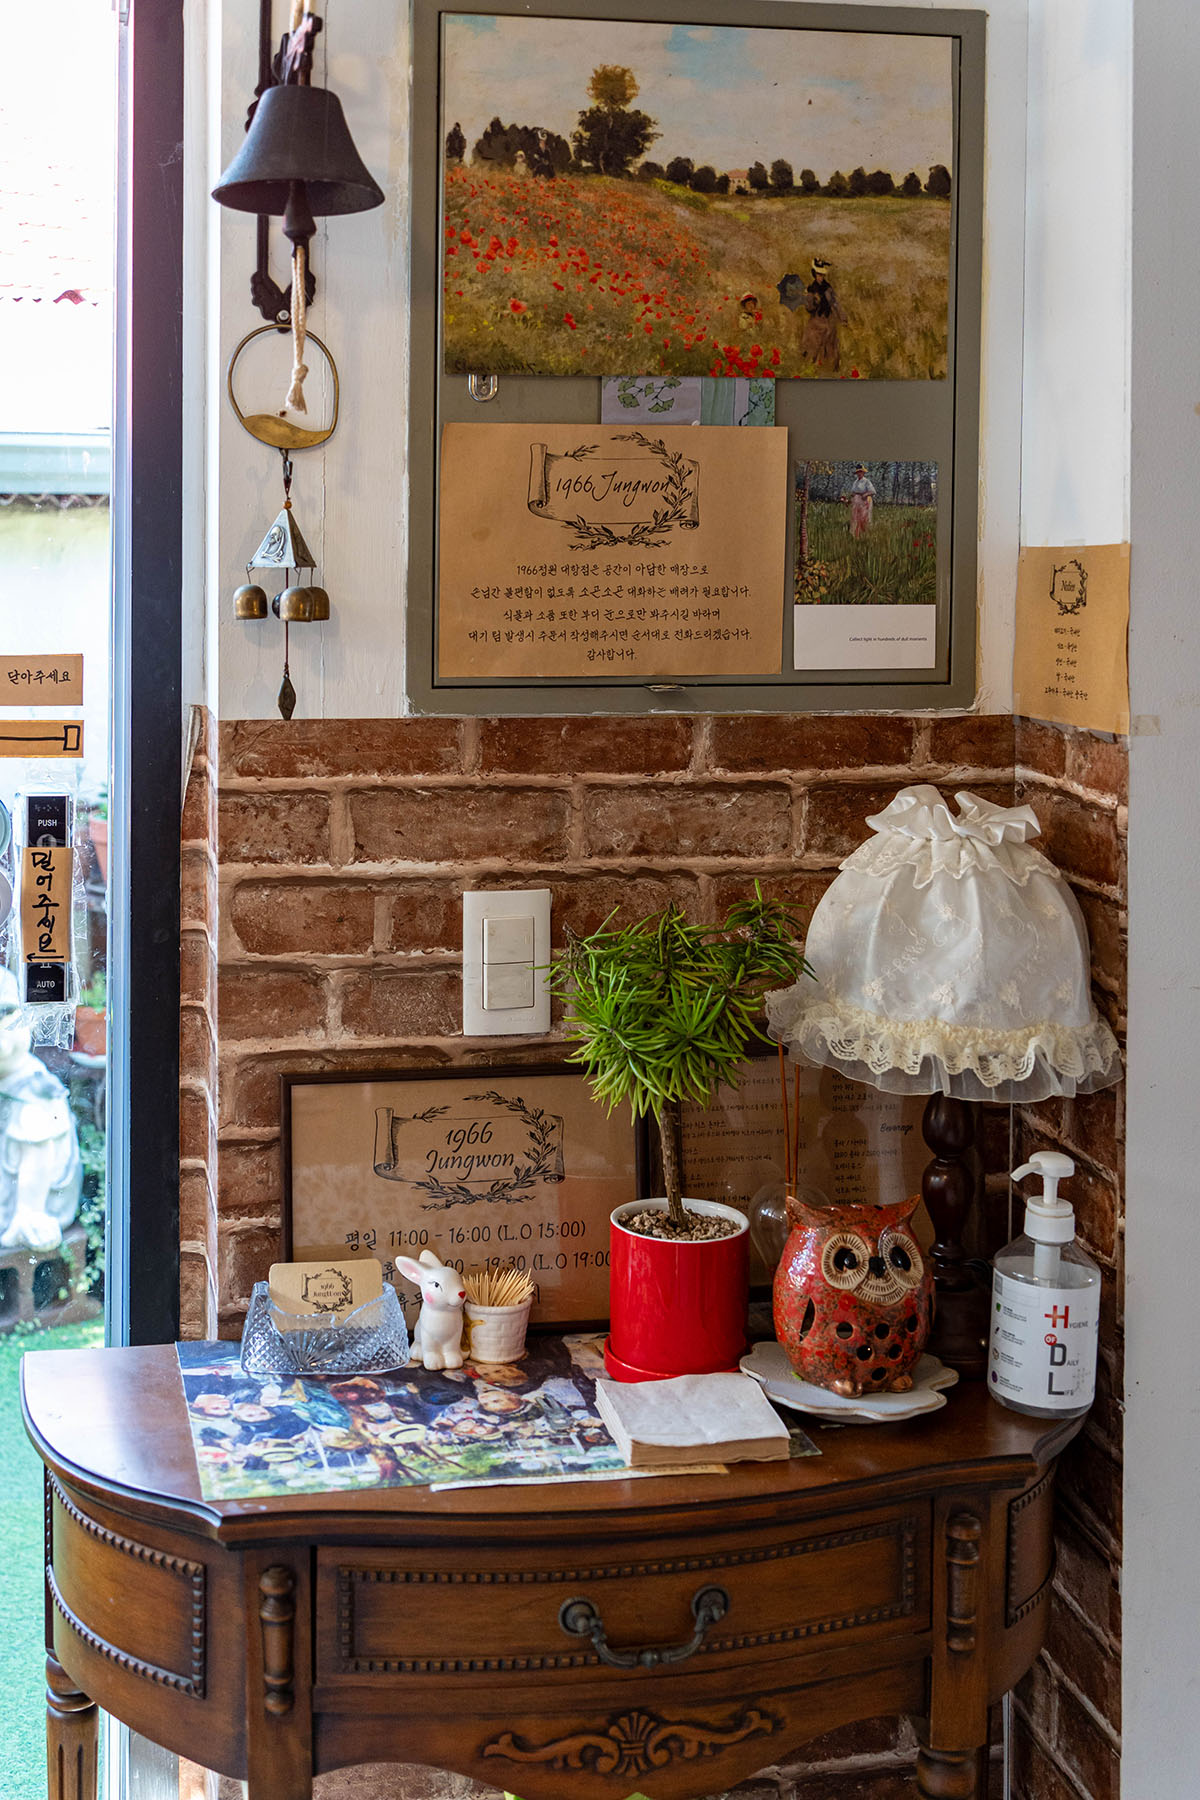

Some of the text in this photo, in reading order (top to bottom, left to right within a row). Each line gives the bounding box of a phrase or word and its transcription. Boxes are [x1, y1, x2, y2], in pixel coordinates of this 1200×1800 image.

[556, 470, 670, 508] 1966 Jungwon
[516, 563, 557, 577] 1966정원
[602, 562, 632, 577] 공간이
[635, 562, 667, 577] 아담한
[669, 563, 710, 577] 매장으로
[470, 585, 752, 600] 손님간 불편함이 없도록 소곤소곤 대화하는 배려가 필요합니다.
[502, 607, 721, 622] 식물과 소품 또한 부디 눈으로만 봐주시길 바라며
[468, 629, 488, 643] 대기
[504, 630, 535, 644] 발생시
[537, 629, 568, 643] 주문서
[570, 629, 629, 643] 작성해주시면
[631, 628, 671, 642] 순서대로
[673, 627, 753, 642] 전화드리겠습니다.
[586, 648, 638, 662] 감사합니다.
[8, 668, 71, 685] 닫아주세요
[37, 819, 58, 827] PUSH
[445, 1121, 493, 1153] 1966
[880, 1122, 914, 1136] Beverage
[425, 1149, 515, 1181] Jungwon
[345, 1229, 377, 1251] 평일
[389, 1229, 429, 1247] 11:00
[449, 1226, 491, 1244] 16:00
[538, 1220, 586, 1239] 15:00)
[484, 1255, 526, 1273] 19:30
